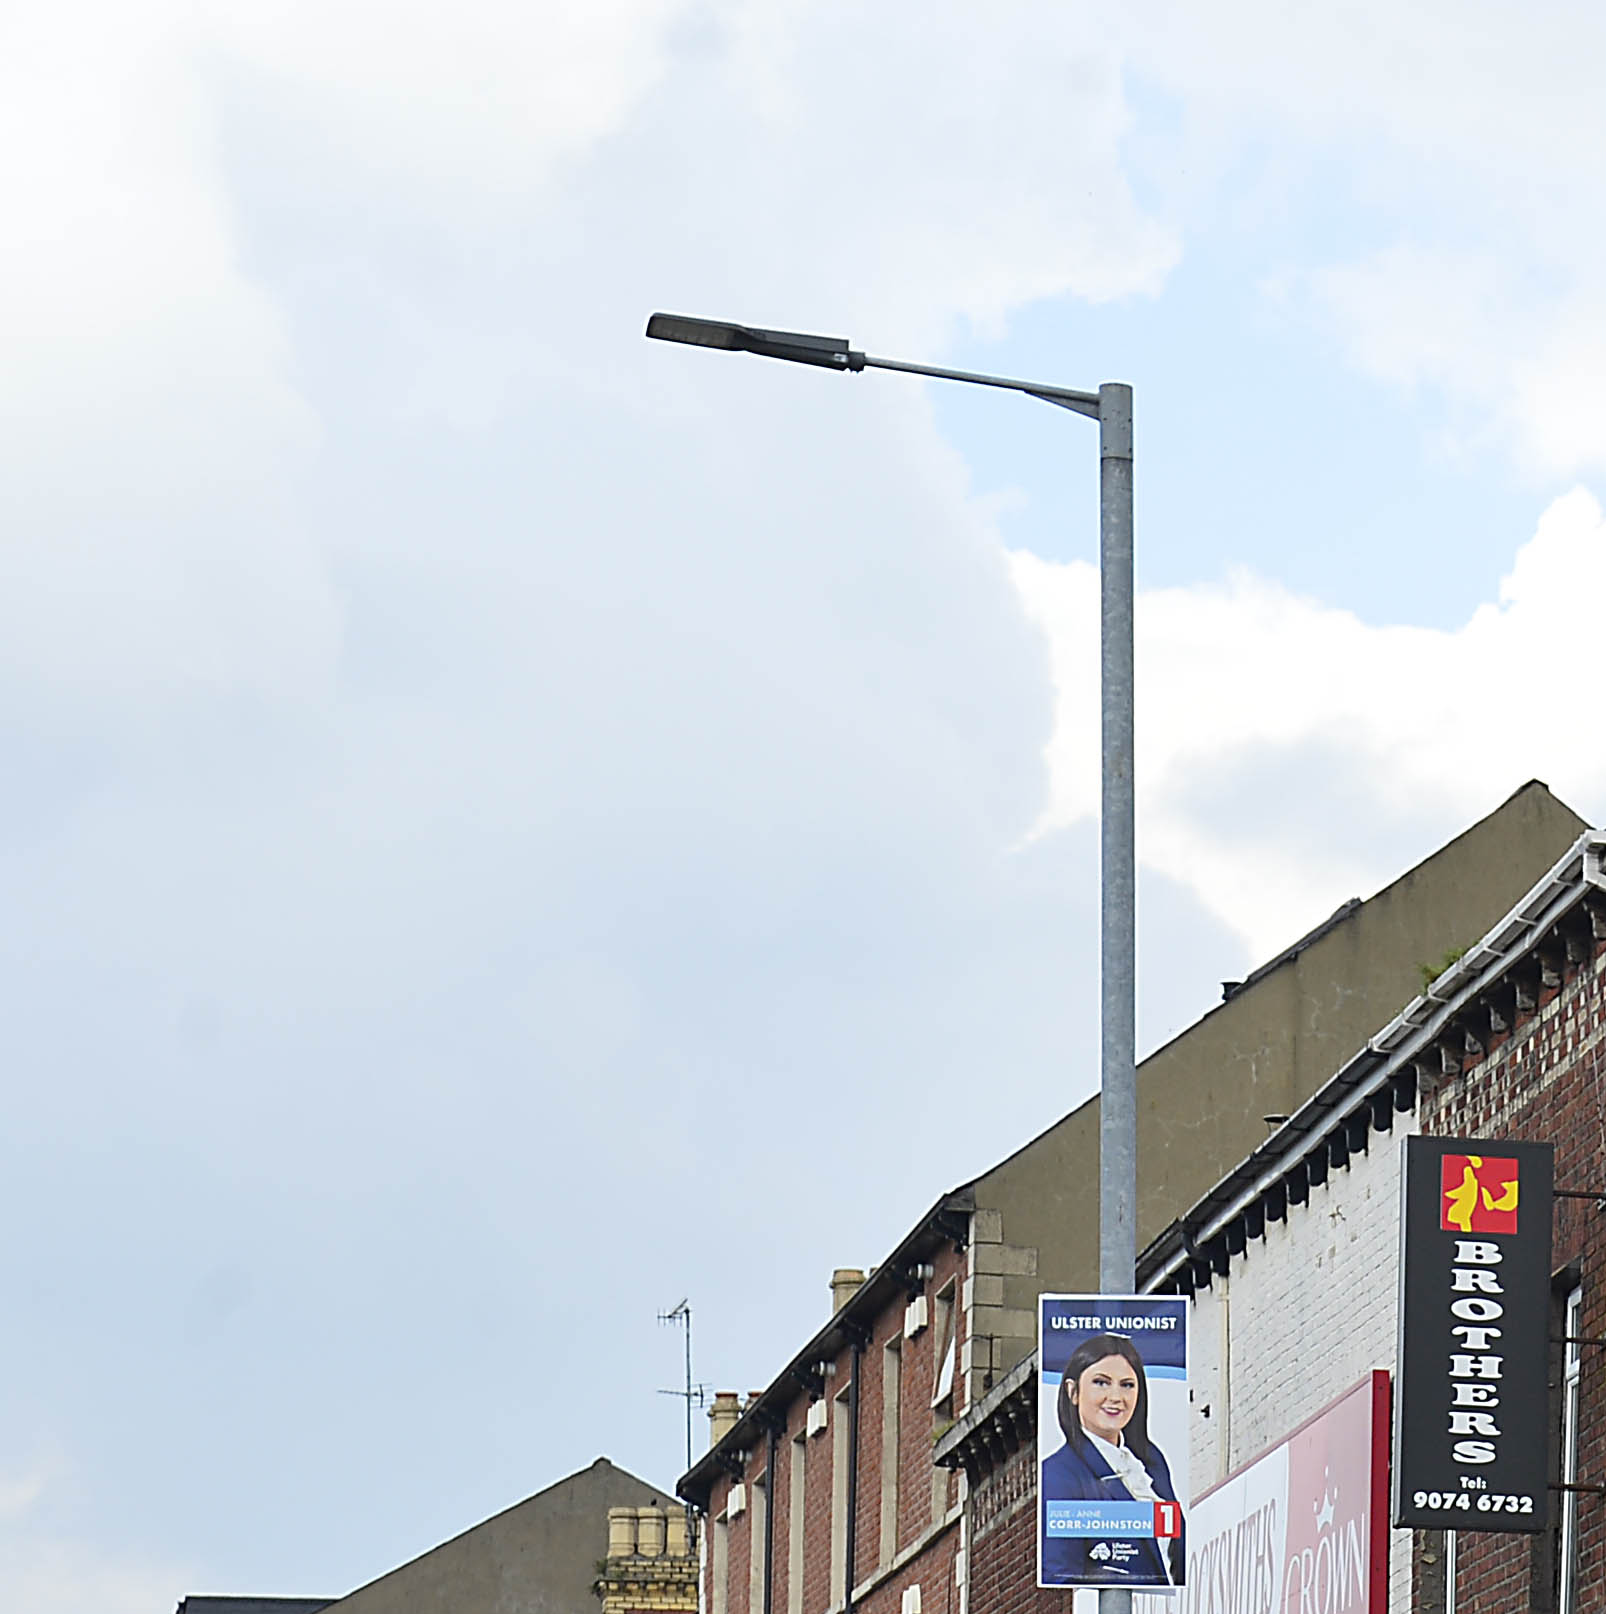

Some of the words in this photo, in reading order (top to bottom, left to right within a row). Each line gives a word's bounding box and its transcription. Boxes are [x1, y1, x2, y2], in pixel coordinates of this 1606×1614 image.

[1051, 1316, 1101, 1329] ULSTER
[1105, 1317, 1177, 1330] UNIONIST
[1448, 1240, 1504, 1464] BROTHERS
[1460, 1476, 1487, 1490] Tel:
[1413, 1492, 1471, 1511] 9074
[1477, 1495, 1533, 1513] 6732
[1049, 1519, 1152, 1530] CORR-JOHNSTON
[1160, 1505, 1174, 1535] 1
